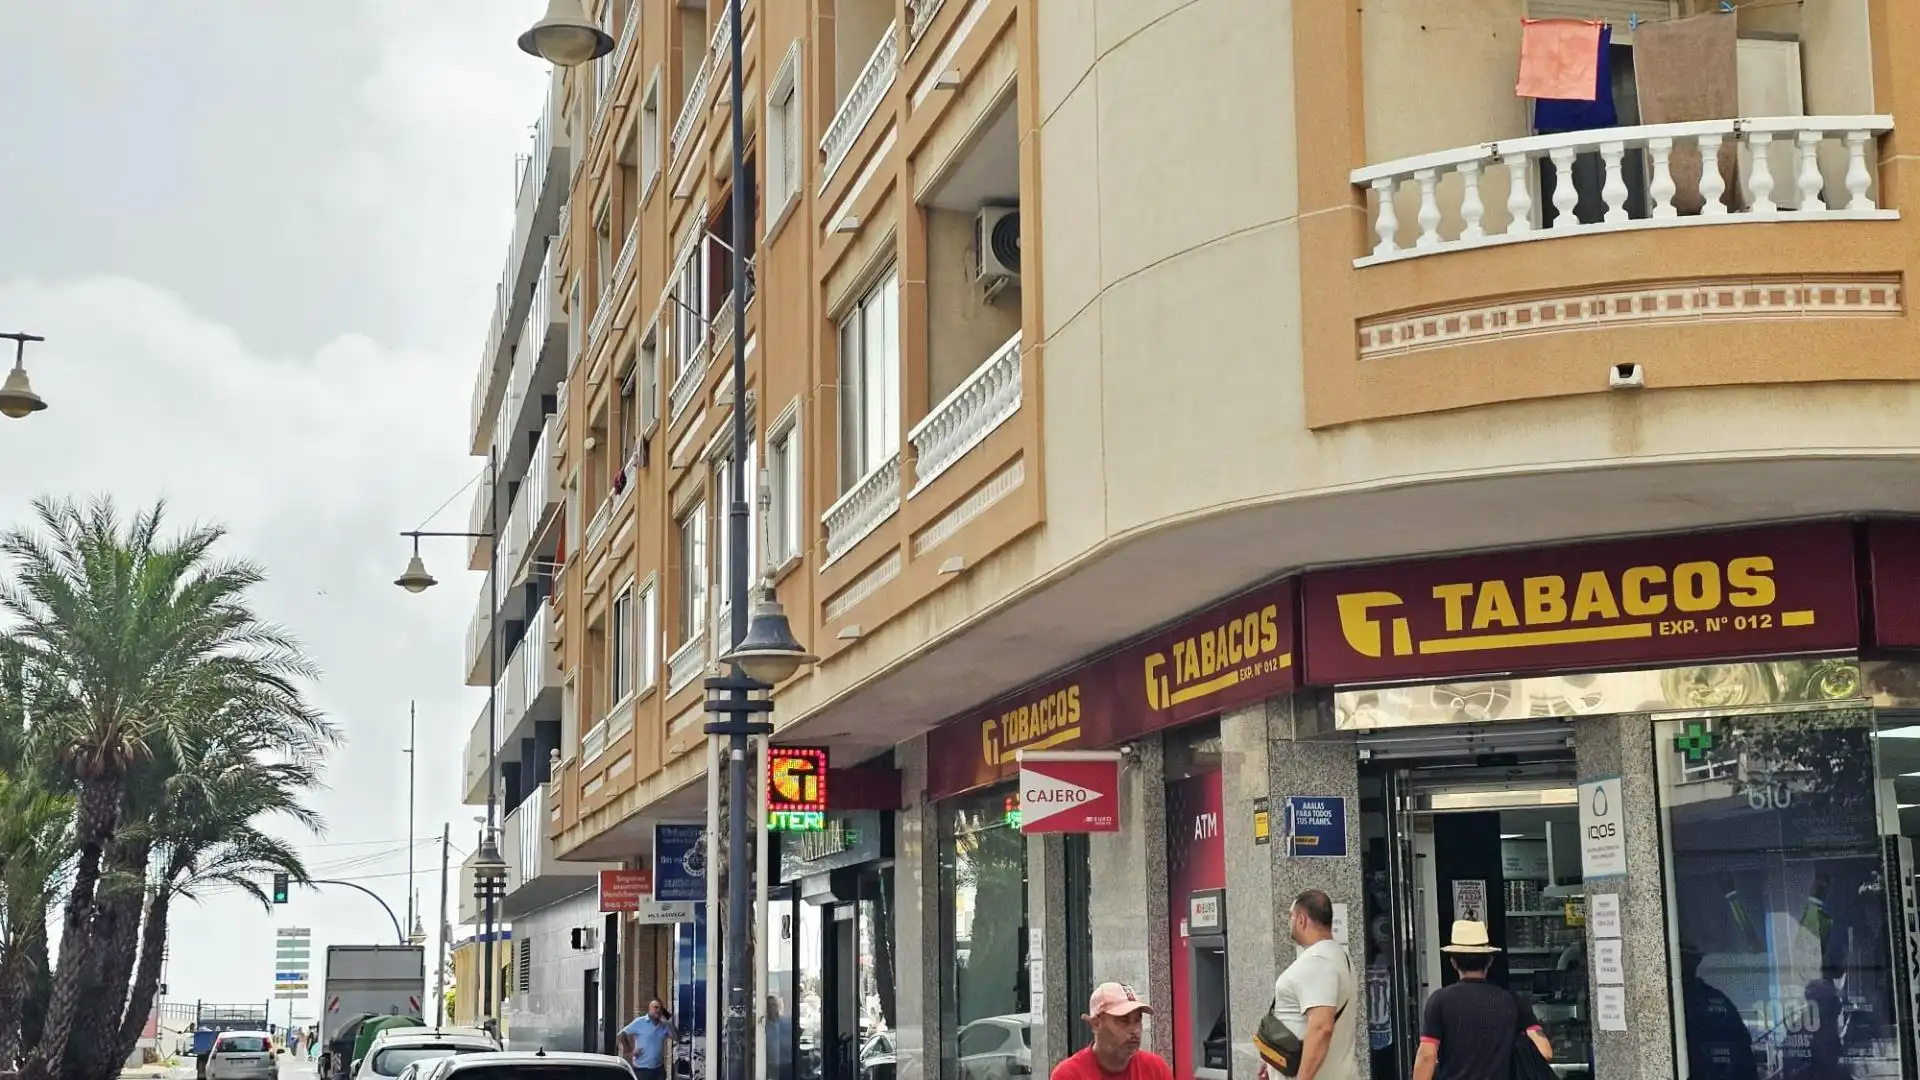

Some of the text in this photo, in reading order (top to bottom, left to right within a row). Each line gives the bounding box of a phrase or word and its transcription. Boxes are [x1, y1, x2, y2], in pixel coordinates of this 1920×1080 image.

[1433, 556, 1775, 631] TABACOS
[1659, 619, 1699, 636] EXP.
[1734, 613, 1772, 630] 012
[1173, 604, 1278, 685] TABACOS
[1240, 668, 1254, 681] EXP.
[1264, 657, 1278, 674] 012
[1002, 685, 1080, 747] TOBACCOS
[1026, 789, 1087, 803] CAJERO
[1296, 810, 1332, 818] PARA TODOS
[1297, 818, 1308, 826] TUS
[1194, 812, 1217, 841] ATM
